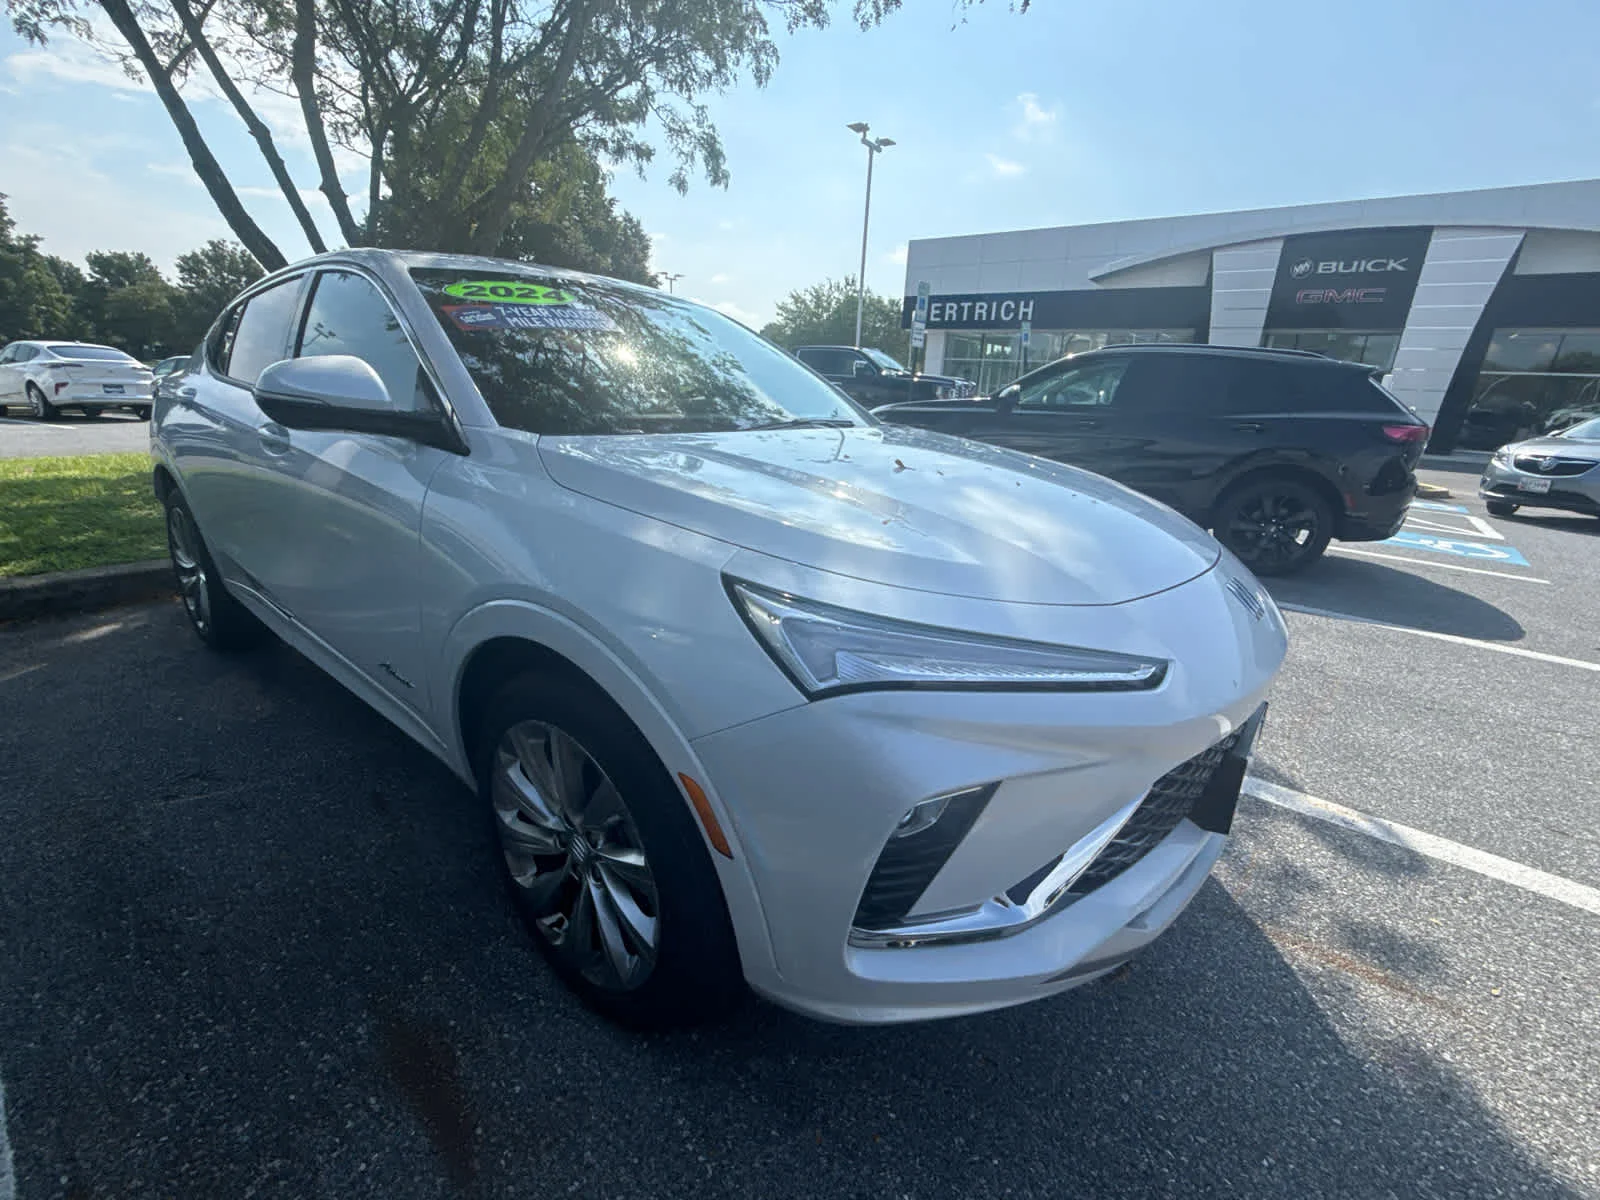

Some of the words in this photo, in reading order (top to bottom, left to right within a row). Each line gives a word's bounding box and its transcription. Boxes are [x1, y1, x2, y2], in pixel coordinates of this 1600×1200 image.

[1316, 257, 1409, 274] BUICK
[461, 284, 568, 301] 2024
[1295, 287, 1388, 304] GMC
[912, 299, 1034, 322] ERTRICH
[505, 316, 545, 328] MILE
[544, 317, 614, 329] WARRAN
